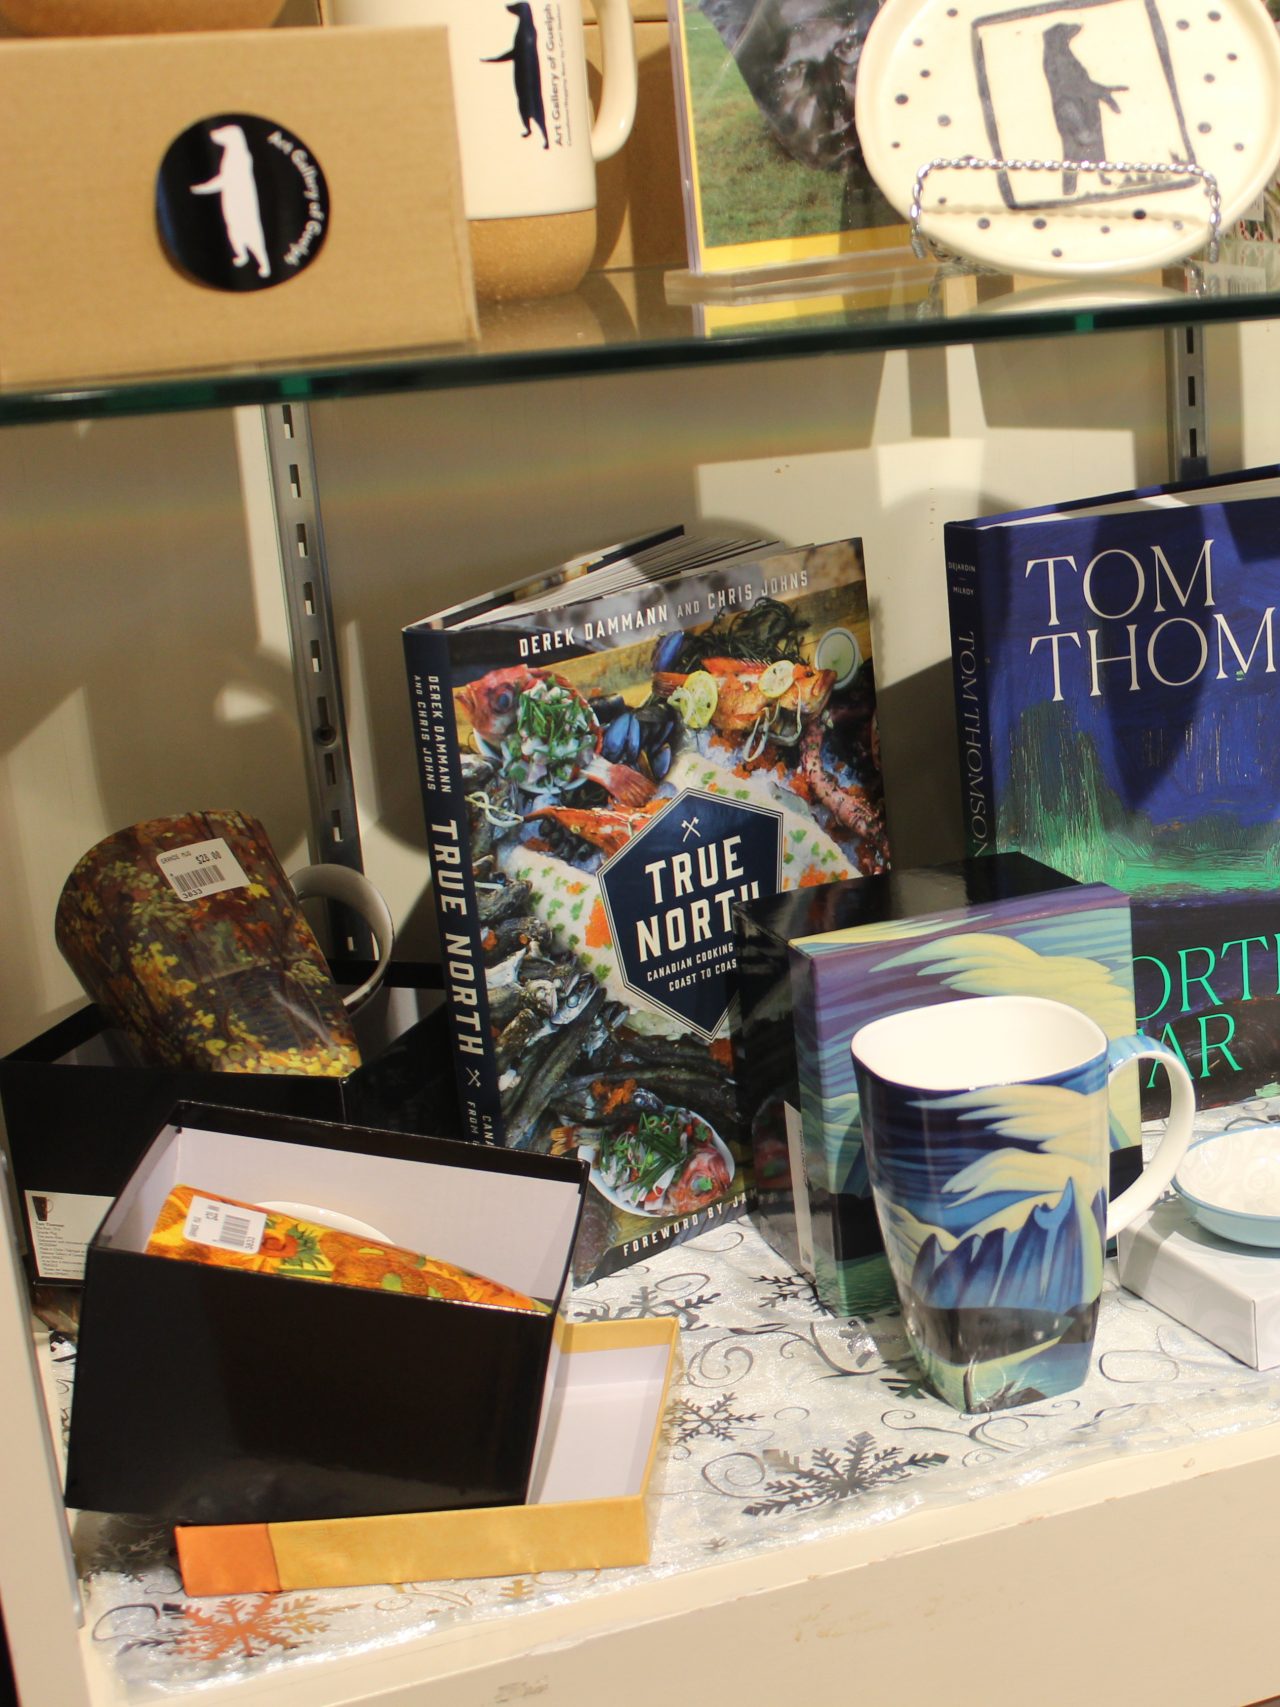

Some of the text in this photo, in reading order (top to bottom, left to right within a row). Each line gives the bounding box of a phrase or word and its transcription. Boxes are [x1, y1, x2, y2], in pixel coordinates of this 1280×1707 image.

[543, 3, 563, 147] Art Gallery of Guelph
[291, 149, 320, 200] Gallery
[309, 201, 325, 222] of
[284, 220, 322, 267] Guelph
[948, 562, 976, 572] DEJARDIN
[953, 585, 974, 596] MILROY
[1025, 538, 1216, 625] TOM
[519, 570, 808, 657] DEREK DAMMANN AND CHRIS JOHNS
[958, 631, 978, 702] TOM
[414, 675, 436, 790] AND CHRIS JOHNS
[428, 675, 452, 793] DEREK DAMMANN
[645, 835, 744, 905] TRUE
[431, 819, 484, 1057] TRUE NORTH
[647, 942, 734, 982] CANADIAN COOKING
[669, 958, 737, 992] COAST TO COAS
[467, 1101, 479, 1134] FROM
[623, 1213, 698, 1256] FOREWORD
[707, 1202, 722, 1219] BY
